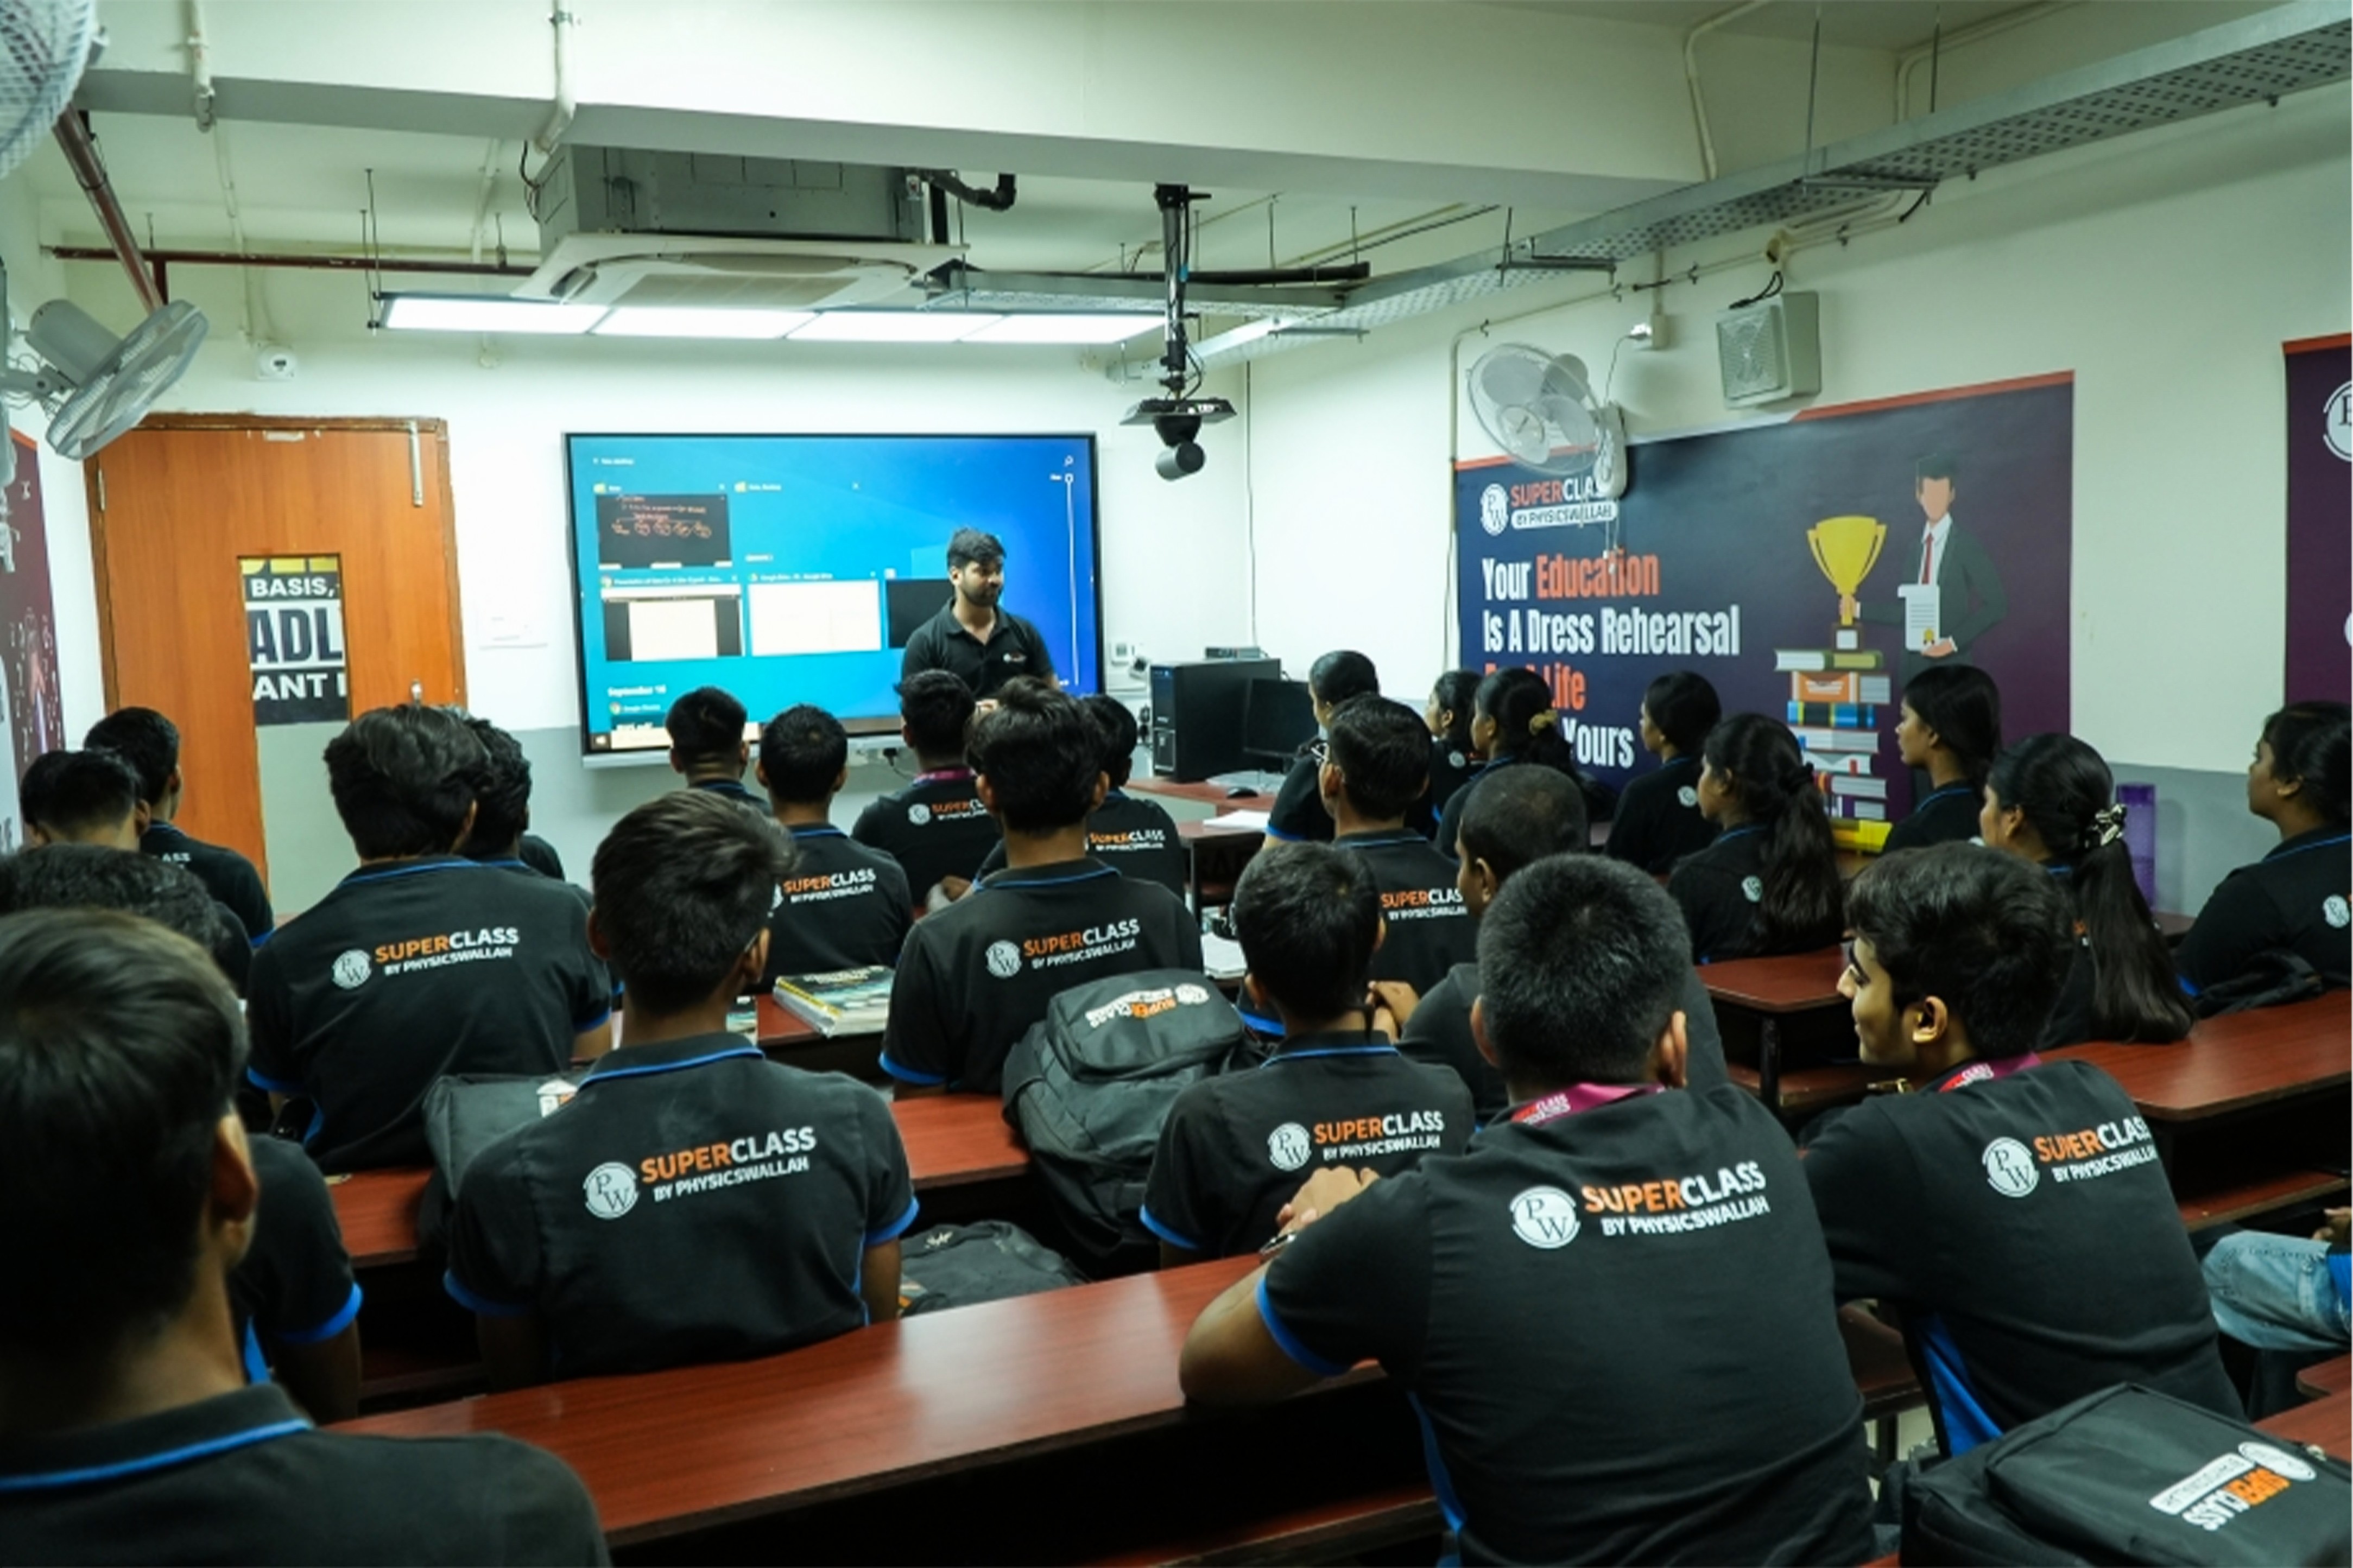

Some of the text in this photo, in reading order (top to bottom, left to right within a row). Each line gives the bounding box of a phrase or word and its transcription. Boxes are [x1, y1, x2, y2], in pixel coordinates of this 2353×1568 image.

[1511, 476, 1604, 507] SUPERCLA
[250, 577, 335, 598] BASIS,
[1482, 548, 1660, 600] Your Education
[1483, 604, 1740, 655] Is A Dress Rehearsal
[252, 673, 328, 701] ANT
[1561, 717, 1635, 769] Yours
[783, 868, 876, 893] SUPERCLASS
[1381, 888, 1463, 907] SUPERCLAS
[375, 927, 520, 963] SUPERCLASS
[1023, 918, 1141, 957] SUPERCLASS
[384, 947, 513, 976] BY PHYSICSWALLAH
[1032, 956, 1044, 969] BY
[1313, 1110, 1445, 1145] SUPERCLASS
[640, 1126, 817, 1184] SUPERCLASS
[1323, 1134, 1441, 1161] BY PHYSICSWALLAH
[653, 1156, 810, 1203] BY PHYSICSWALLAH
[1580, 1160, 1767, 1214] SUPERCLASS
[1601, 1195, 1770, 1236] BY PHYSICSWALLAH
